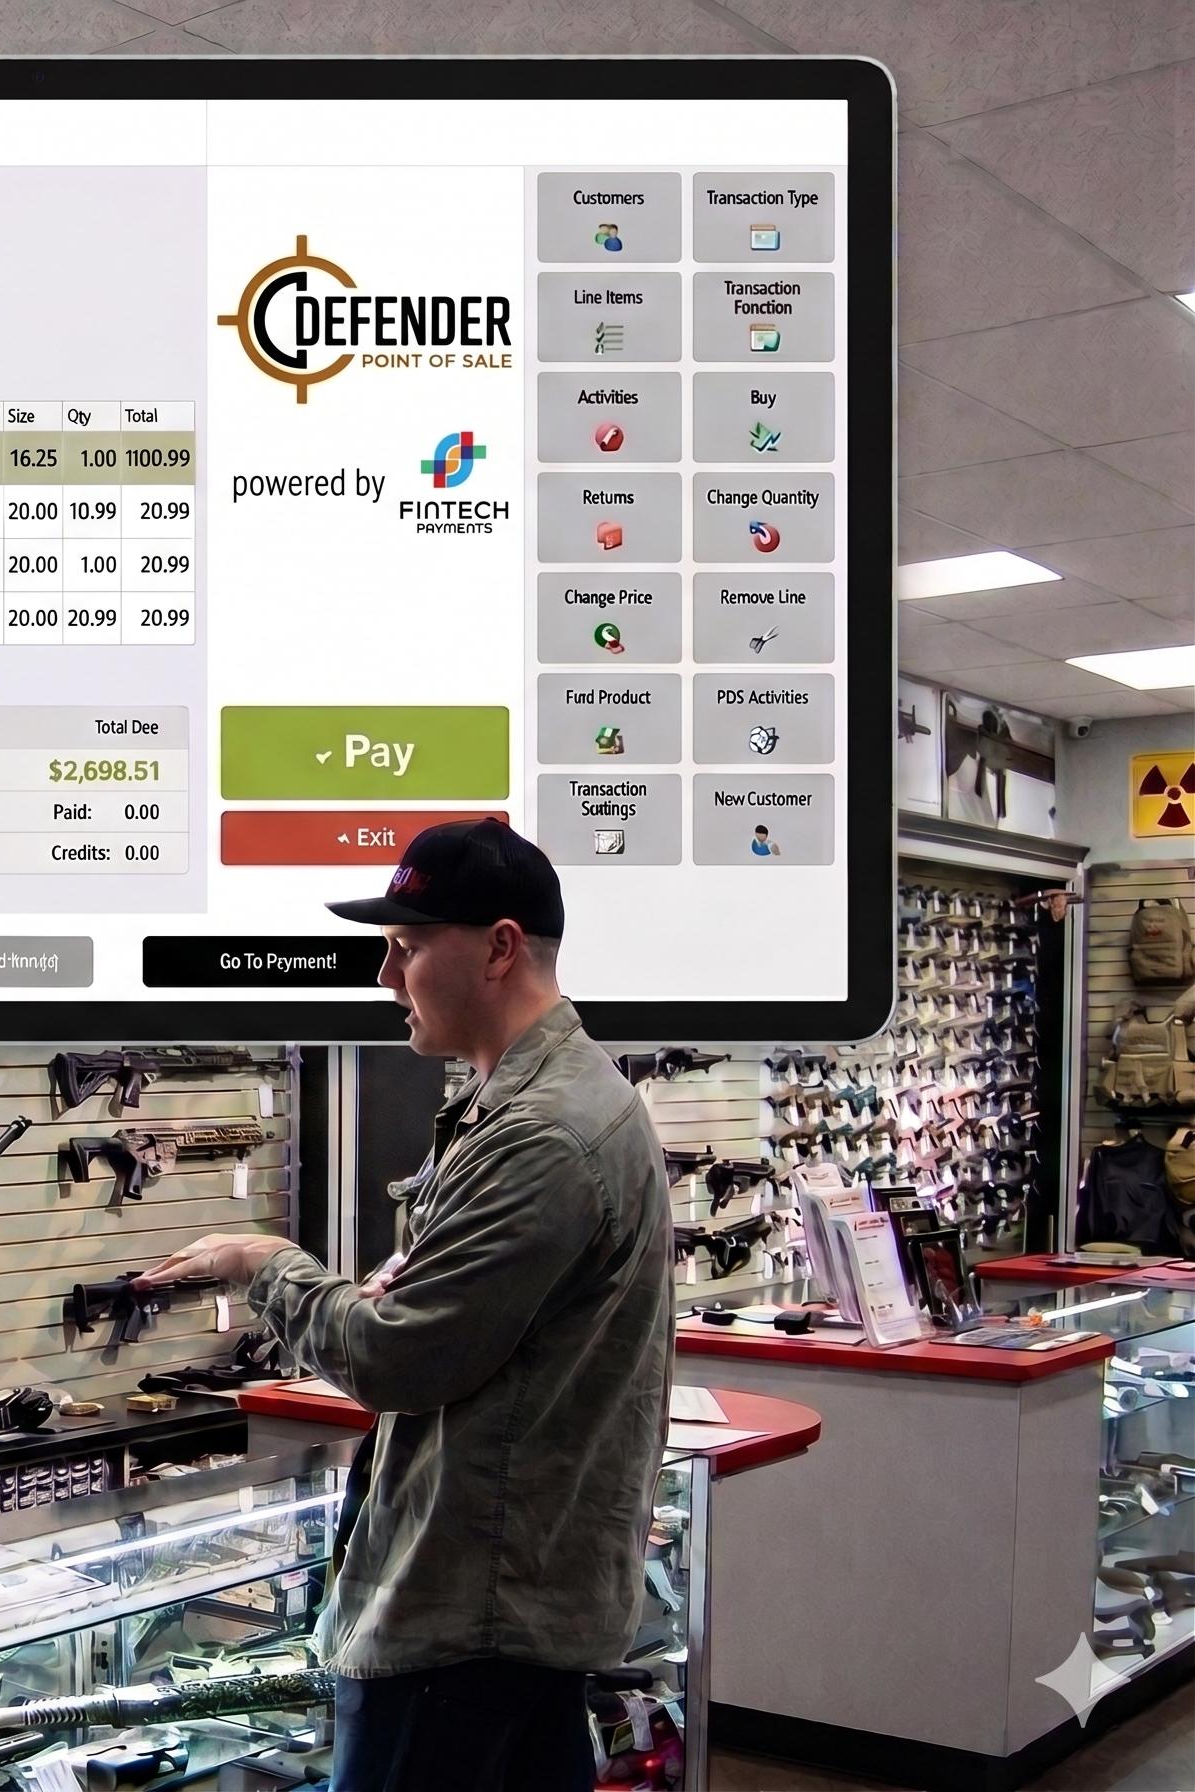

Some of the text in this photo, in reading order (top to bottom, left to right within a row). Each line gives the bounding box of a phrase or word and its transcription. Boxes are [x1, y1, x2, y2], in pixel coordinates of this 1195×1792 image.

[573, 189, 645, 206] Customers
[706, 189, 819, 209] Transaction Type
[574, 289, 644, 305] Line Items
[723, 280, 801, 296] Transaction
[734, 299, 793, 315] Fonction
[362, 353, 513, 369] POINT OF SALE
[577, 389, 639, 405] Activities
[750, 389, 777, 409] Buy
[7, 408, 35, 424] Size
[67, 408, 92, 427] Qty
[124, 407, 158, 423] Total
[10, 448, 58, 468] 16.25
[80, 449, 117, 468] 1.00
[125, 448, 191, 468] 1100.99
[233, 467, 386, 504] powered by
[707, 488, 820, 510] Change Quantity
[8, 502, 58, 521] 20.00
[69, 501, 117, 520] 10.99
[140, 501, 190, 520] 20.99
[8, 555, 58, 574] 20.00
[80, 555, 117, 574] 1.00
[140, 555, 190, 574] 20.99
[564, 588, 653, 609] Change Price
[720, 588, 807, 605] Remove Line
[8, 609, 58, 627] 20.00
[67, 609, 117, 627] 20.99
[140, 608, 190, 627] 20.99
[598, 689, 652, 705] Product
[717, 689, 809, 705] PDS Activities
[94, 719, 159, 735] Total Dee
[345, 734, 415, 777] Pay
[49, 758, 159, 785] $2,698.51
[568, 780, 647, 797] Transaction
[714, 790, 813, 807] New Customer
[53, 803, 92, 820] Paid:
[124, 803, 160, 820] 0.00
[357, 827, 396, 847] Exit
[51, 844, 111, 861] Credits:
[125, 844, 160, 861] 0.00
[220, 952, 241, 970] Go
[243, 952, 263, 970] To
